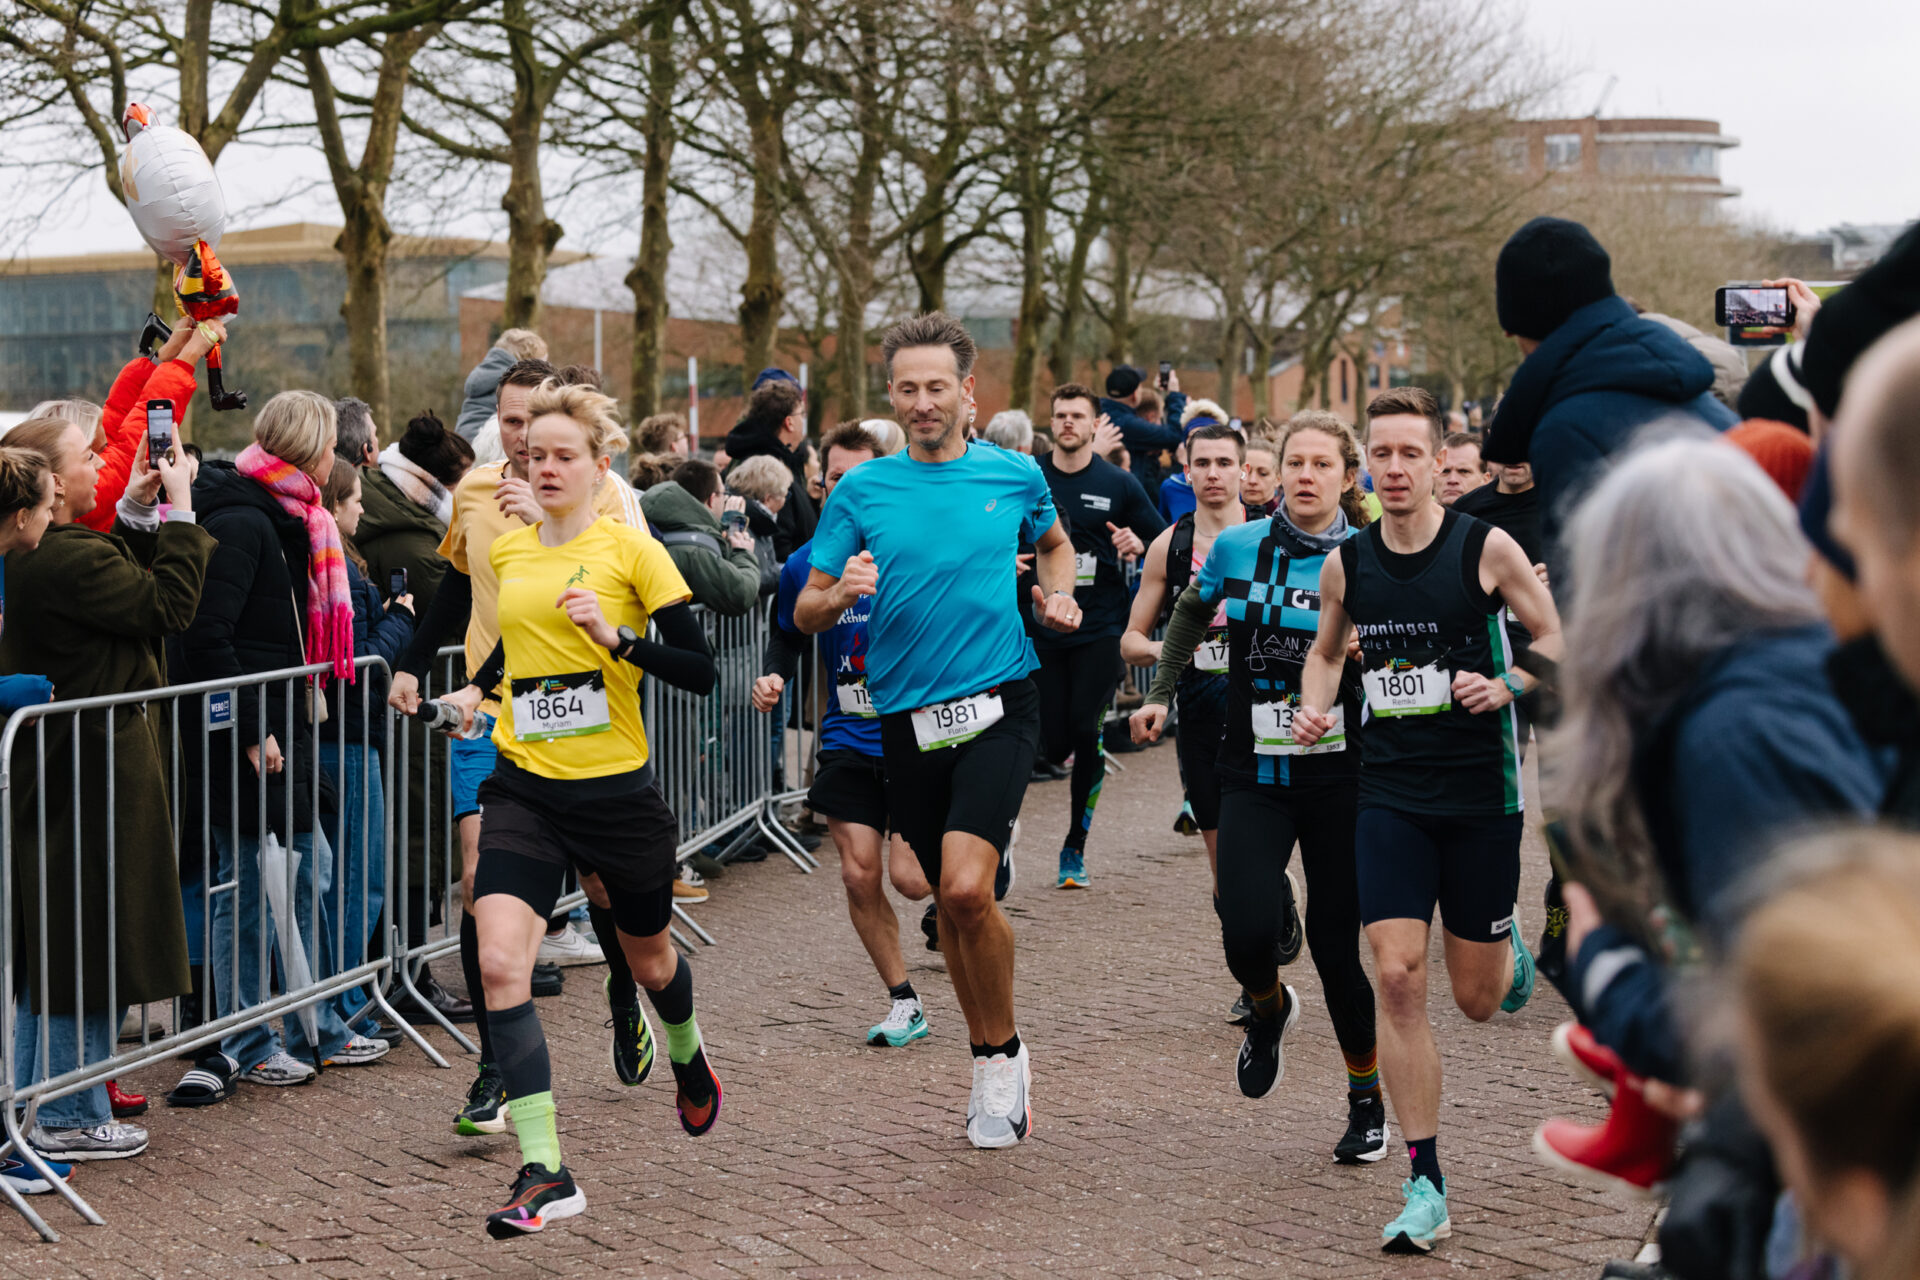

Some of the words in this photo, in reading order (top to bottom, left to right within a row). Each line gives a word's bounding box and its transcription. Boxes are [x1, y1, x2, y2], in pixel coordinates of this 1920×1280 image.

[1208, 645, 1230, 661] 17
[1378, 674, 1424, 697] 1801
[529, 695, 584, 720] 1864
[932, 703, 978, 729] 1981
[542, 720, 572, 731] Myriam
[1273, 708, 1301, 728] 13
[947, 726, 968, 736] Floris
